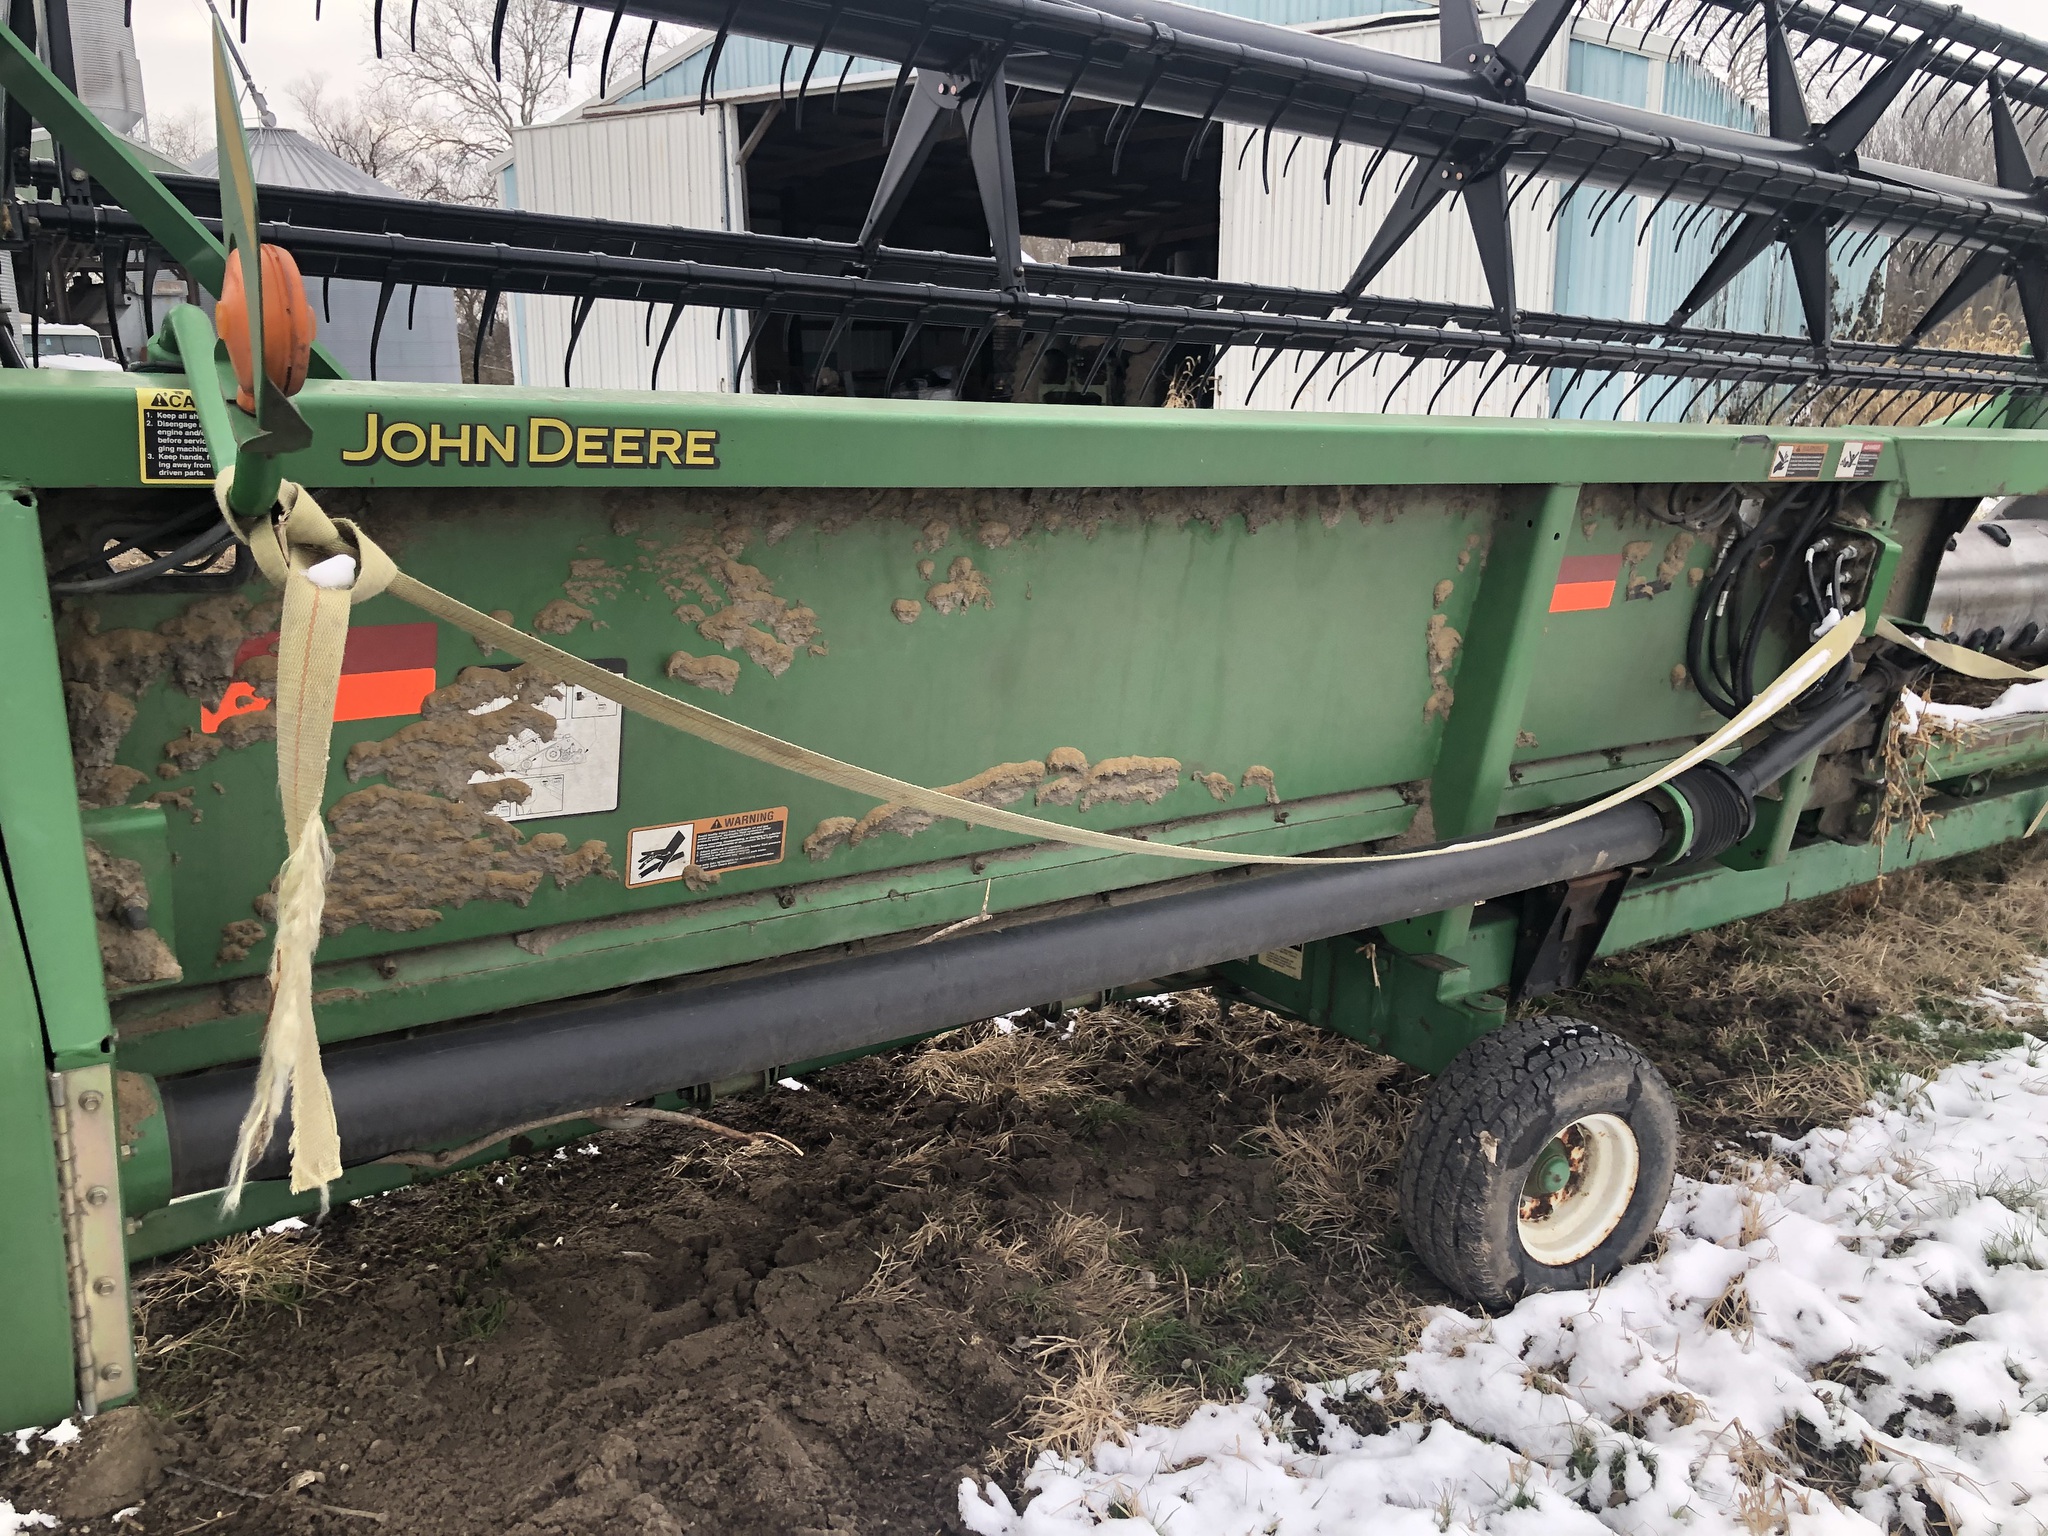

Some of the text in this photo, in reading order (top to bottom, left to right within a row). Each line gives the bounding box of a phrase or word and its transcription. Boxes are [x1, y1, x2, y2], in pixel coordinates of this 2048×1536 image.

[157, 412, 176, 420] Keep
[157, 420, 198, 428] Disengage
[341, 412, 719, 468] JOHN DEERE
[724, 810, 774, 828] WARNING
